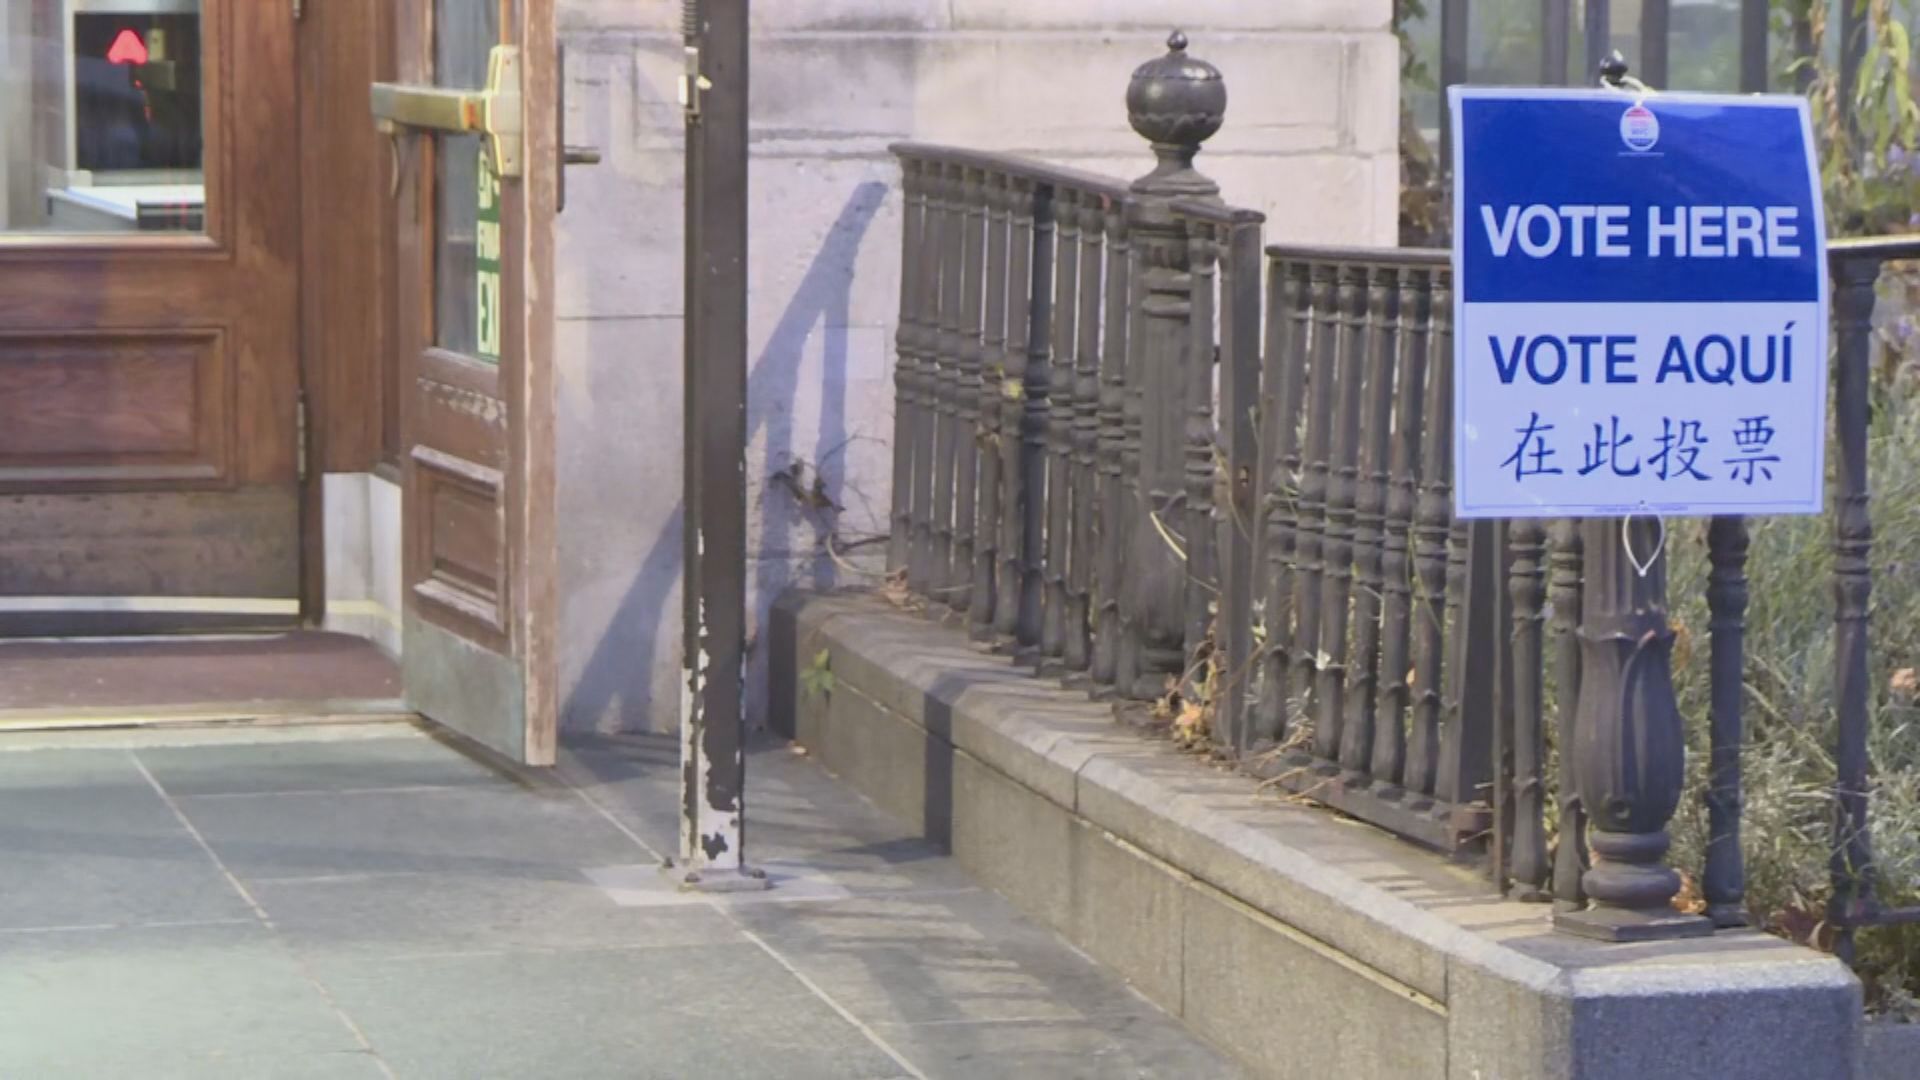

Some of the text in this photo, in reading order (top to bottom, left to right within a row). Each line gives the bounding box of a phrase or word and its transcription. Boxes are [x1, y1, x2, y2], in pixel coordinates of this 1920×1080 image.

[1481, 204, 1800, 257] VOTE HERE
[1488, 321, 1796, 386] VOTE AQUÍ
[1500, 411, 1781, 485] 在此投票
